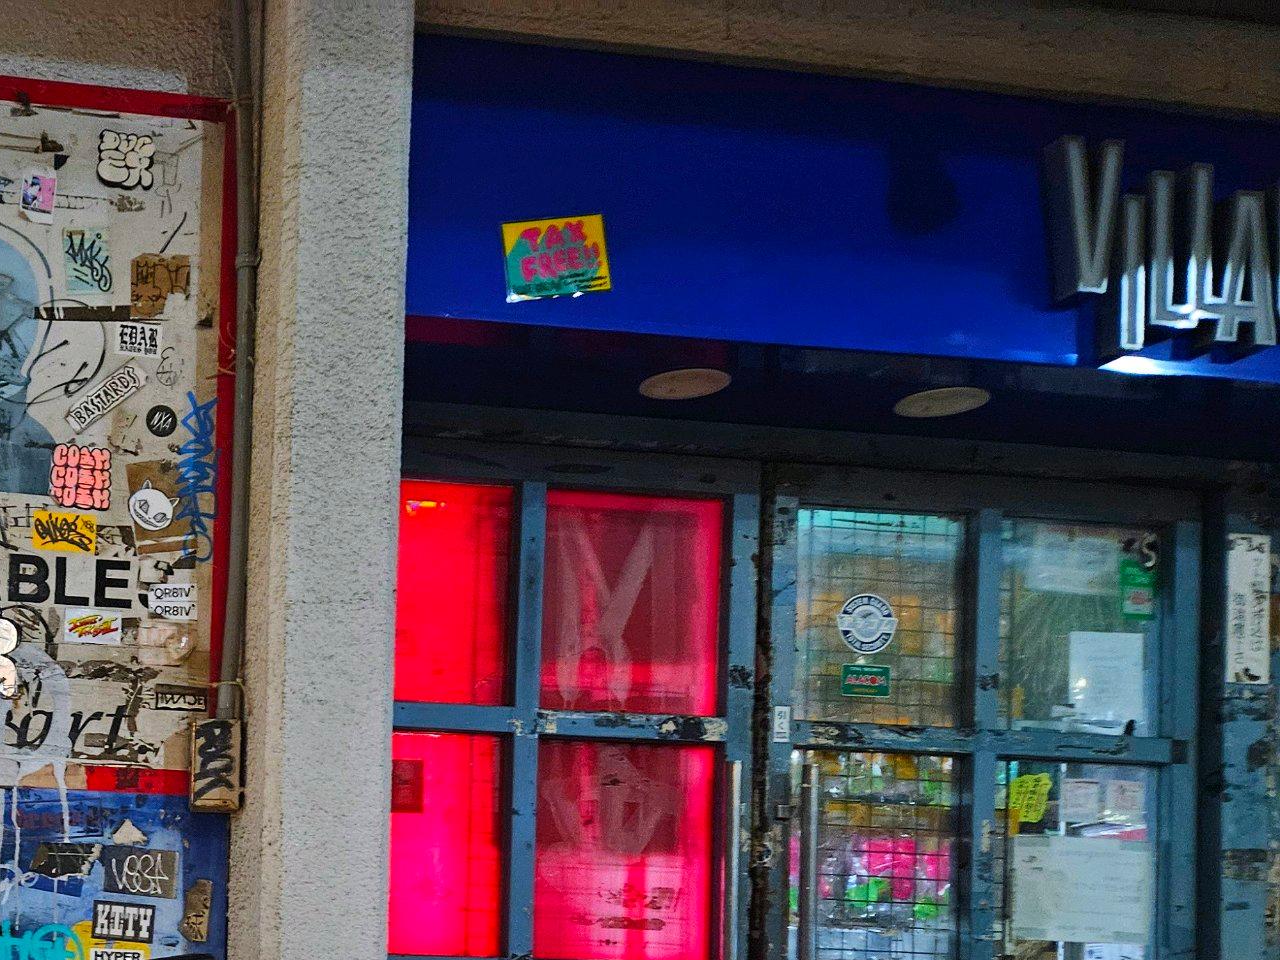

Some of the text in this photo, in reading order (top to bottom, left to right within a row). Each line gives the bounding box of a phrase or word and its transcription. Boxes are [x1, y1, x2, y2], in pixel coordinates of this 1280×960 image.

[520, 220, 587, 252] TAX
[1052, 133, 1280, 350] VILLA
[73, 367, 138, 426] BASTARDS
[94, 903, 154, 939] KITY
